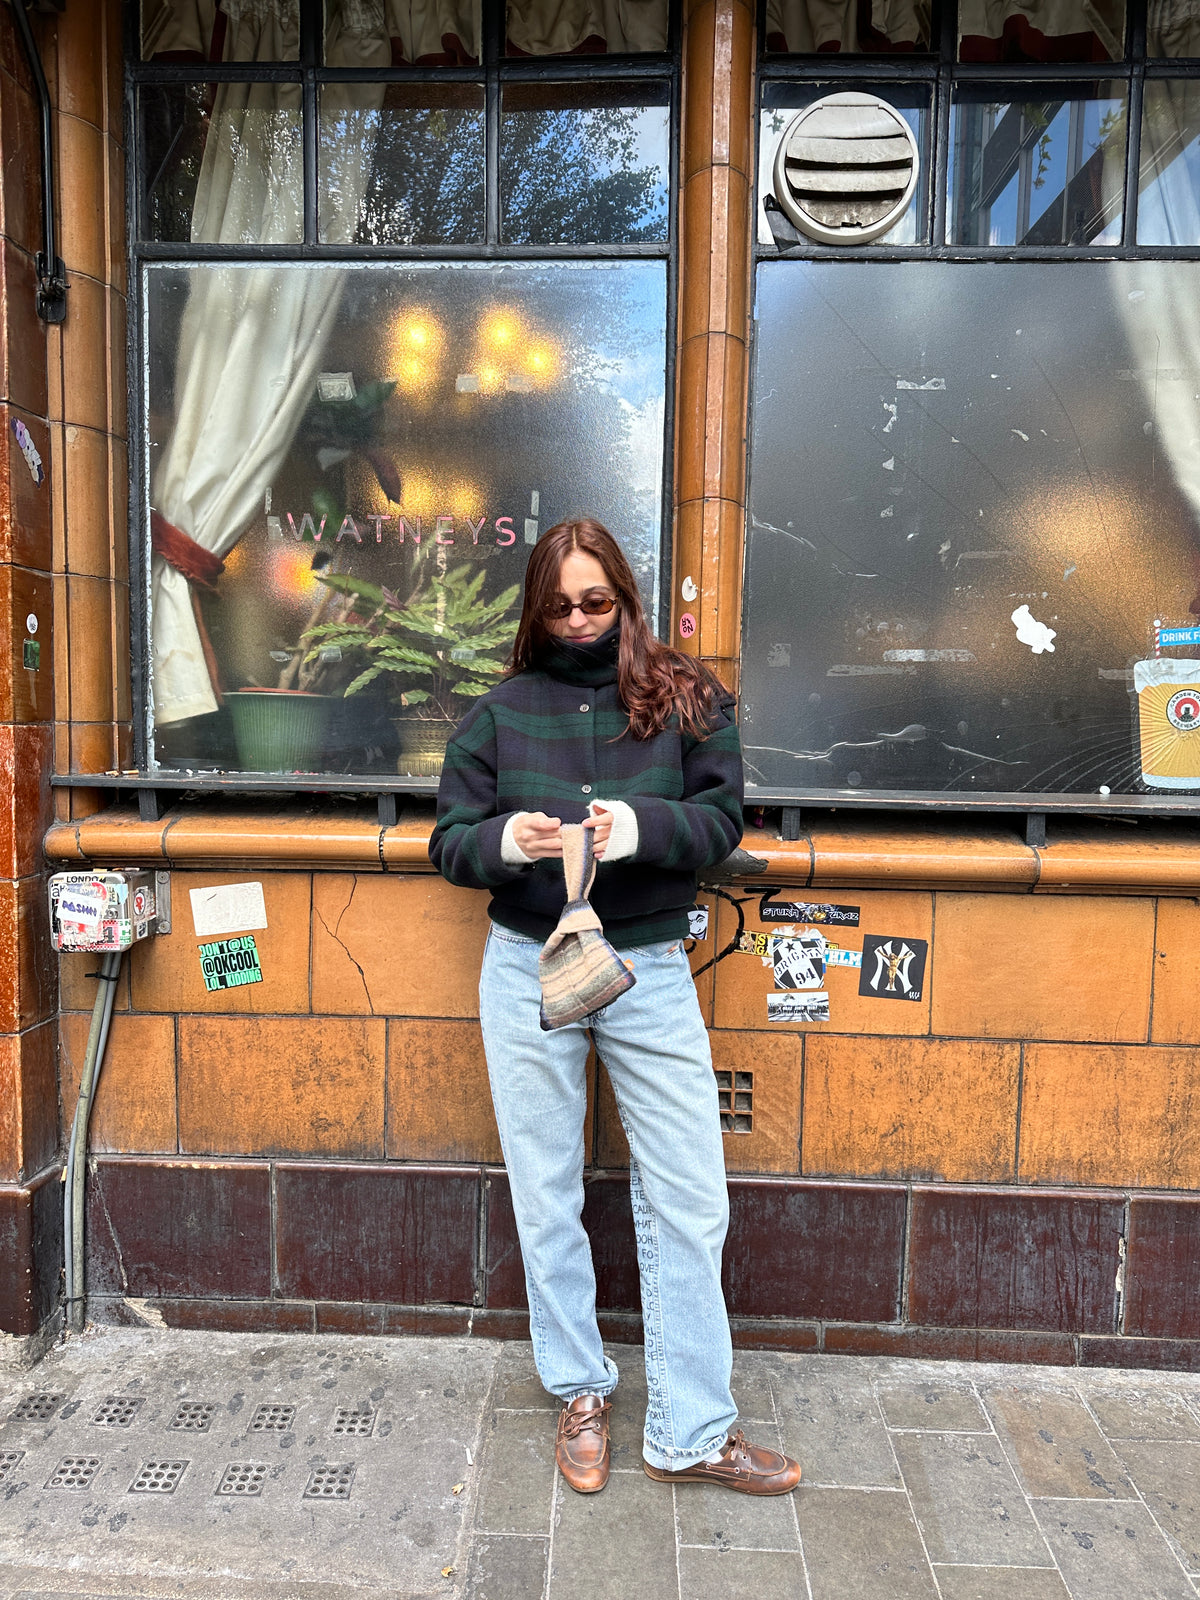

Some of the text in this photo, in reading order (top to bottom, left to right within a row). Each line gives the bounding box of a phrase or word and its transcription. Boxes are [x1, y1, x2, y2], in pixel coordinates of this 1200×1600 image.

[287, 512, 517, 547] WATNEYS
[1162, 631, 1192, 642] DRINK
[66, 875, 106, 884] LONDO
[203, 950, 259, 977] @OKCOOL
[774, 947, 824, 976] BRIGATA
[226, 970, 262, 987] KIDDING
[795, 967, 817, 985] 94
